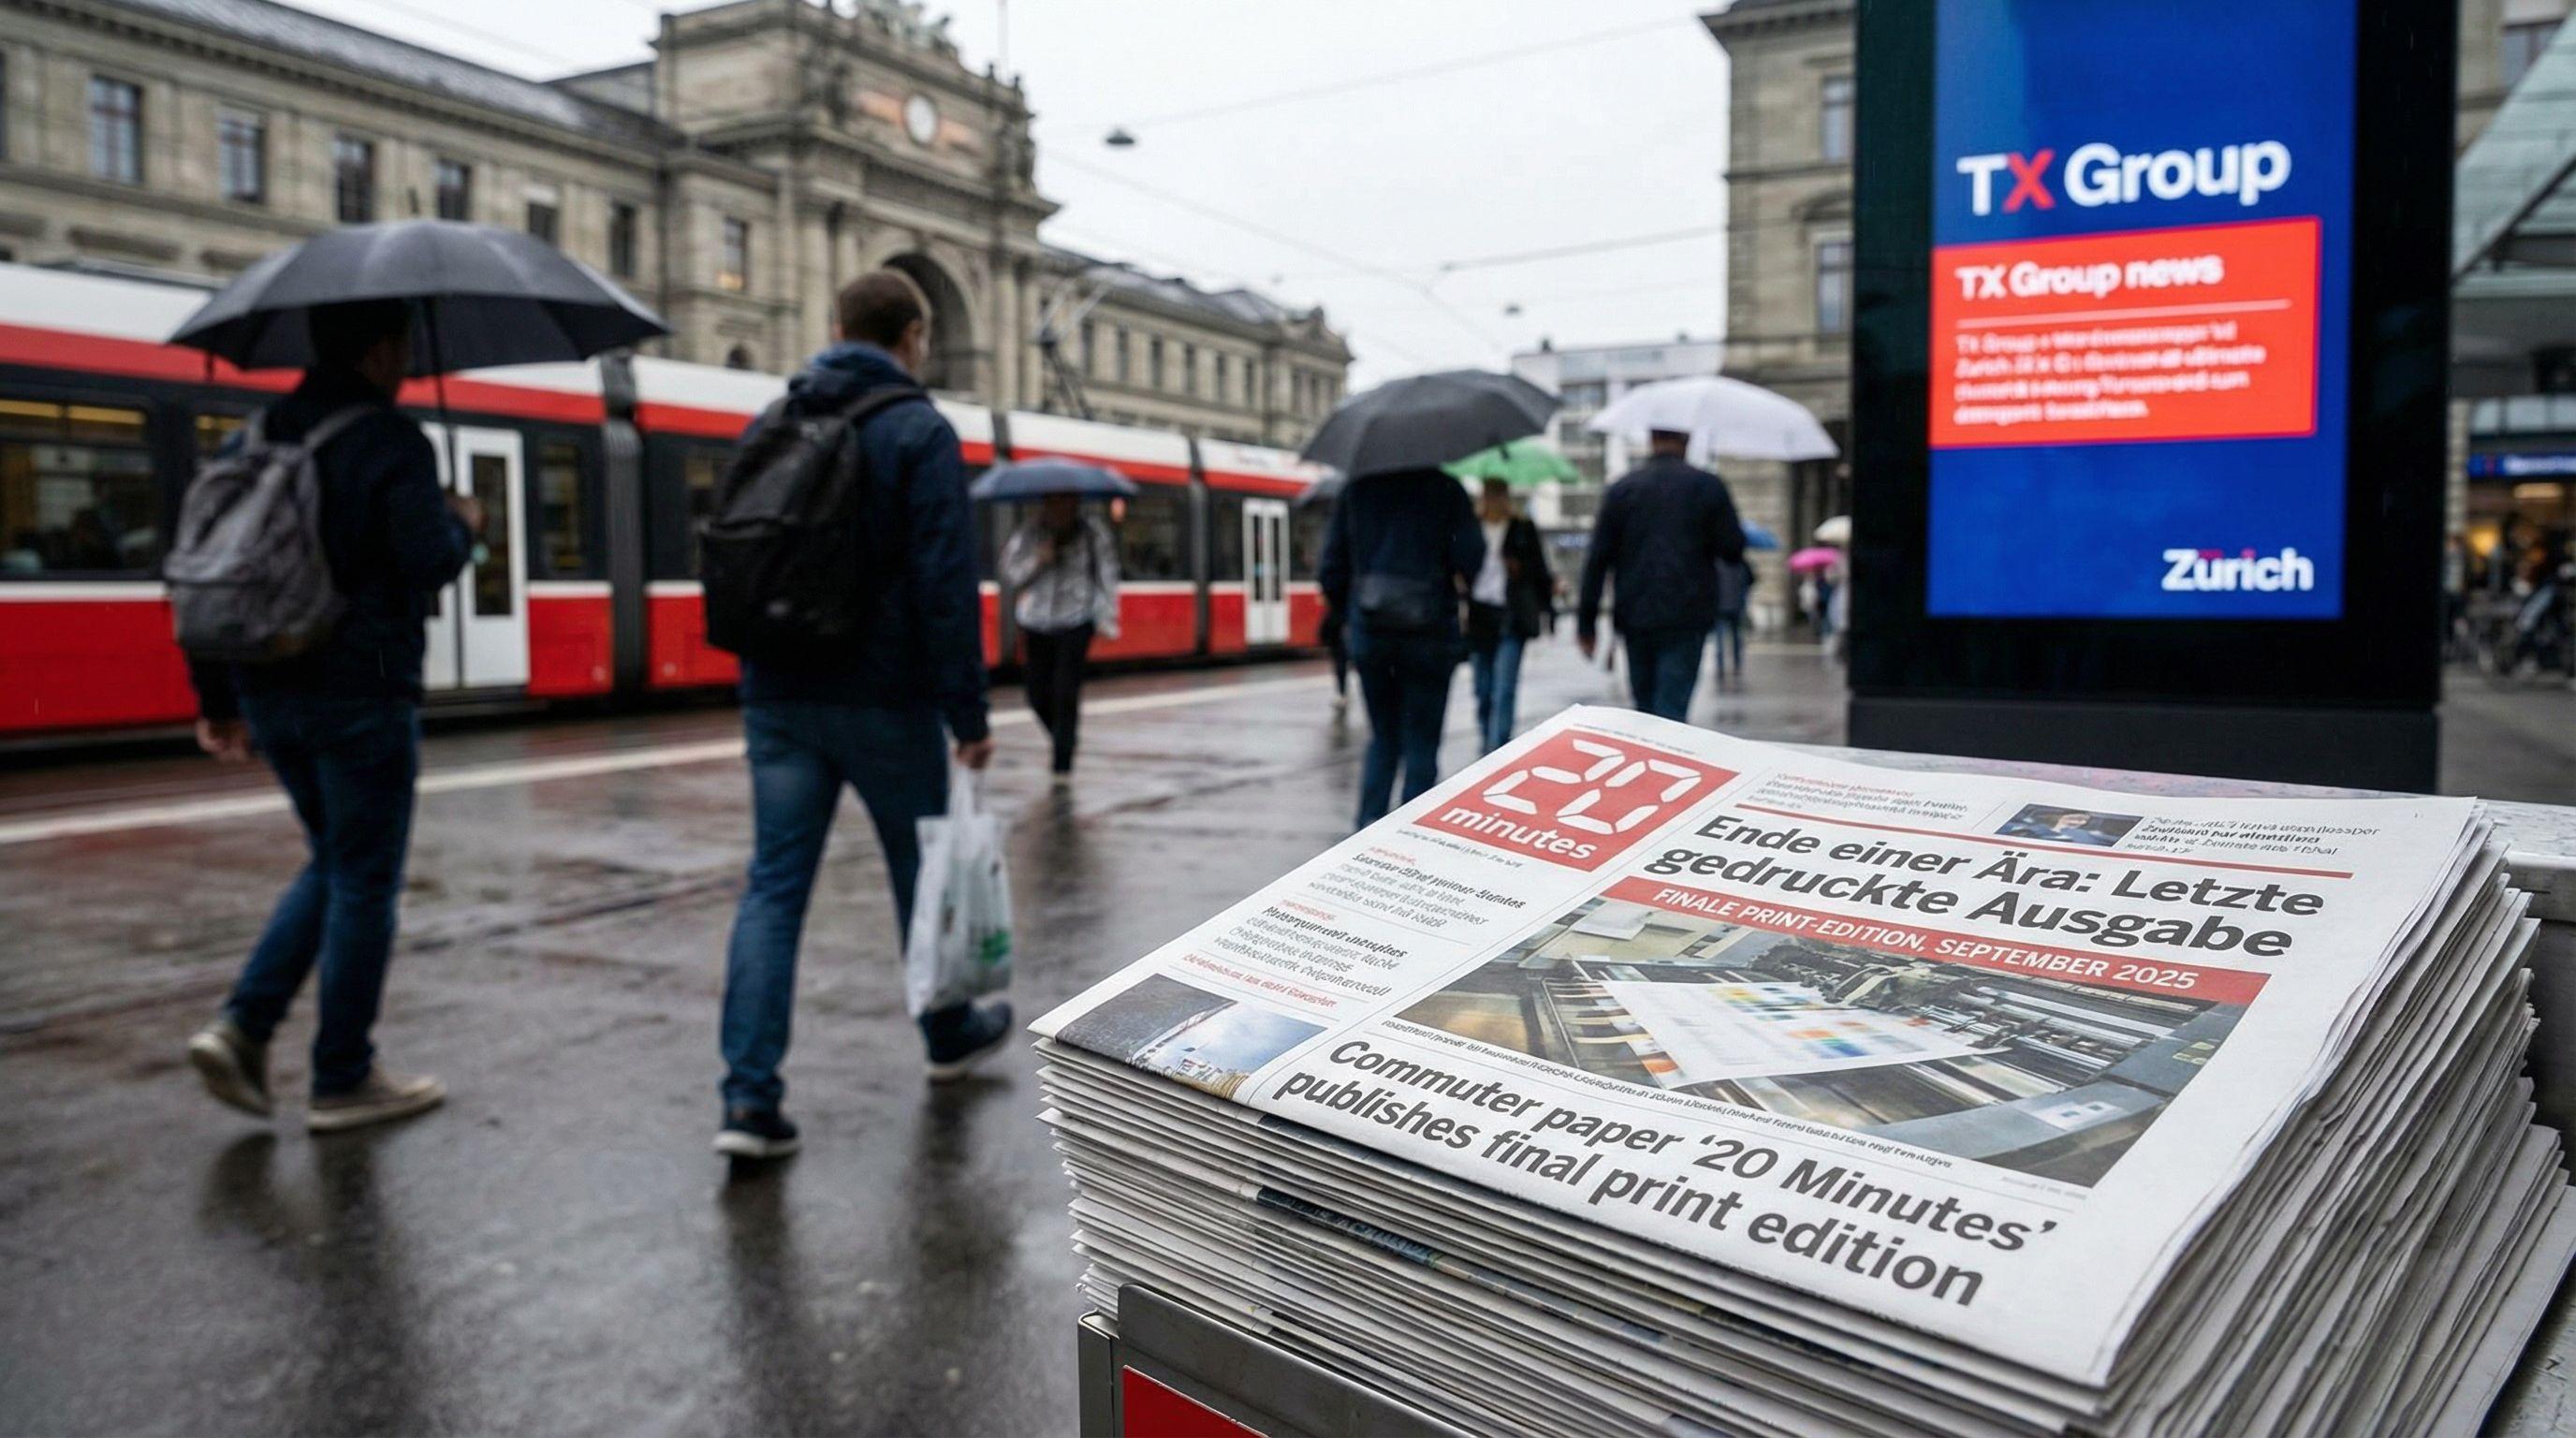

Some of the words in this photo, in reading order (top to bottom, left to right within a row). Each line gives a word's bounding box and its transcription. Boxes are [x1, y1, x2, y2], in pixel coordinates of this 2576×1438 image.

[1956, 150, 2056, 216] TX
[2064, 140, 2292, 206] Group
[1954, 264, 2007, 300] TX
[2009, 259, 2120, 299] Group
[2124, 254, 2225, 288] news
[2160, 547, 2315, 592] Zürich
[1440, 806, 1598, 860] minutes
[1482, 738, 1703, 836] 20
[1644, 847, 1959, 915] gedruckte
[1966, 890, 2293, 958] Ausgabe
[1695, 814, 1822, 854] Ende
[1828, 841, 1972, 875] einer
[1971, 850, 2101, 893] Ära:
[2111, 869, 2325, 917] Letzte
[1652, 888, 1740, 918] FINALE
[1736, 904, 1927, 956] PRINT-EDITION,
[1932, 939, 2107, 979] SEPTEMBER
[2112, 962, 2197, 990] 2025
[1271, 1070, 1482, 1151] publishes
[1479, 1128, 1603, 1188] final
[1588, 1167, 1743, 1231] print
[1747, 1210, 1984, 1308] edition
[1329, 1039, 1545, 1119] Commuter
[1530, 1106, 1685, 1155] paper
[1779, 1158, 2058, 1252] Minutes’
